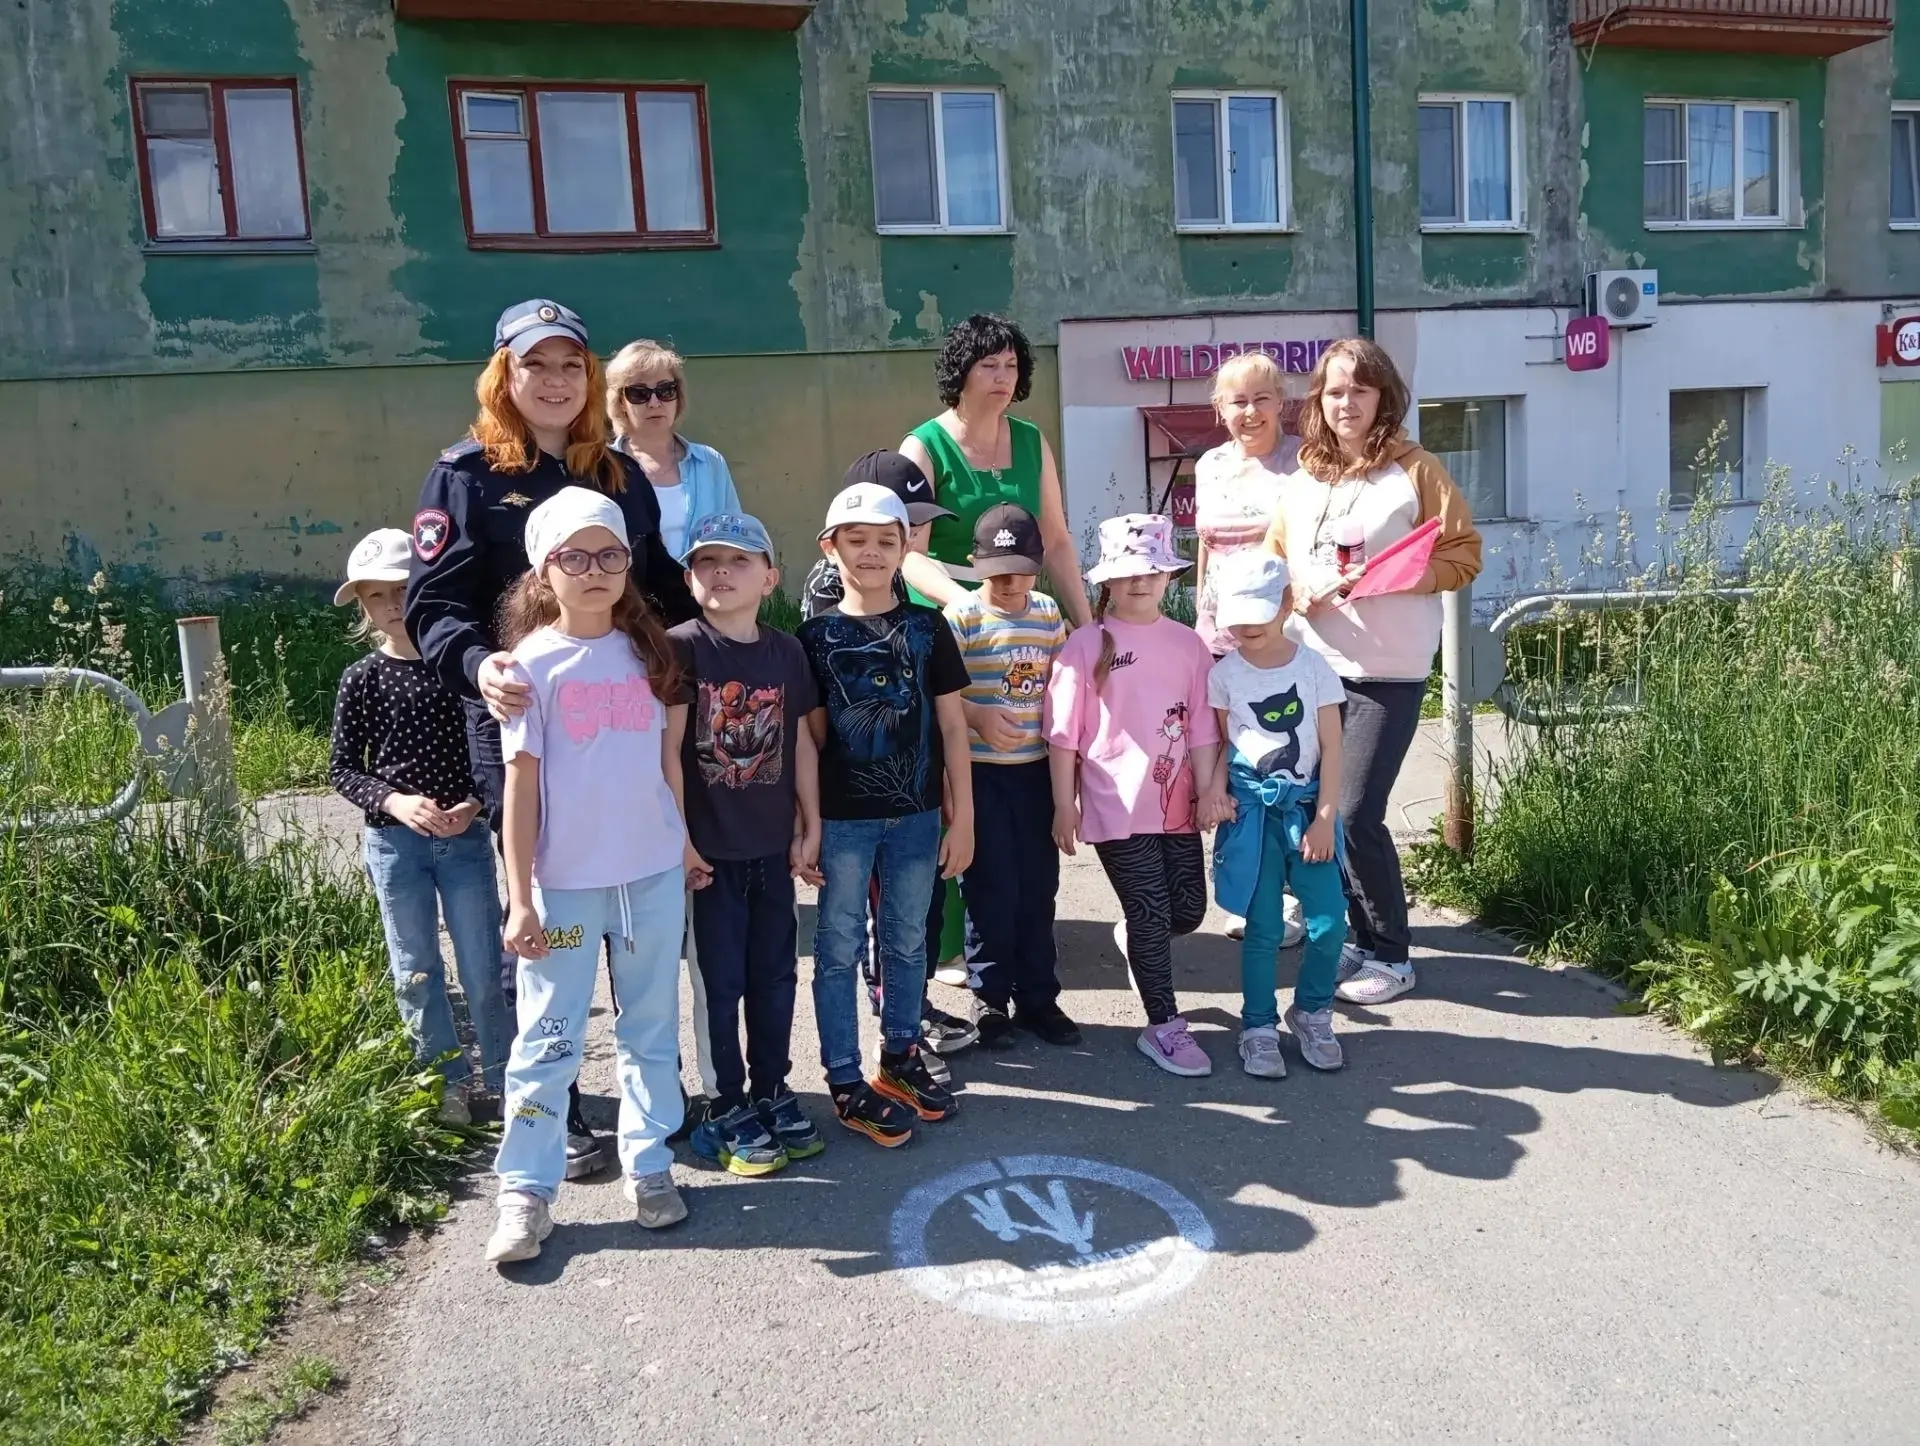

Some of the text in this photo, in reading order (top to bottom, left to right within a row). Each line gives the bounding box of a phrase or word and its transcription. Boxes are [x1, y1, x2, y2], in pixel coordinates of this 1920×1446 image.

[1567, 331, 1597, 356] WB
[1899, 331, 1920, 352] K&
[1109, 651, 1138, 671] hill
